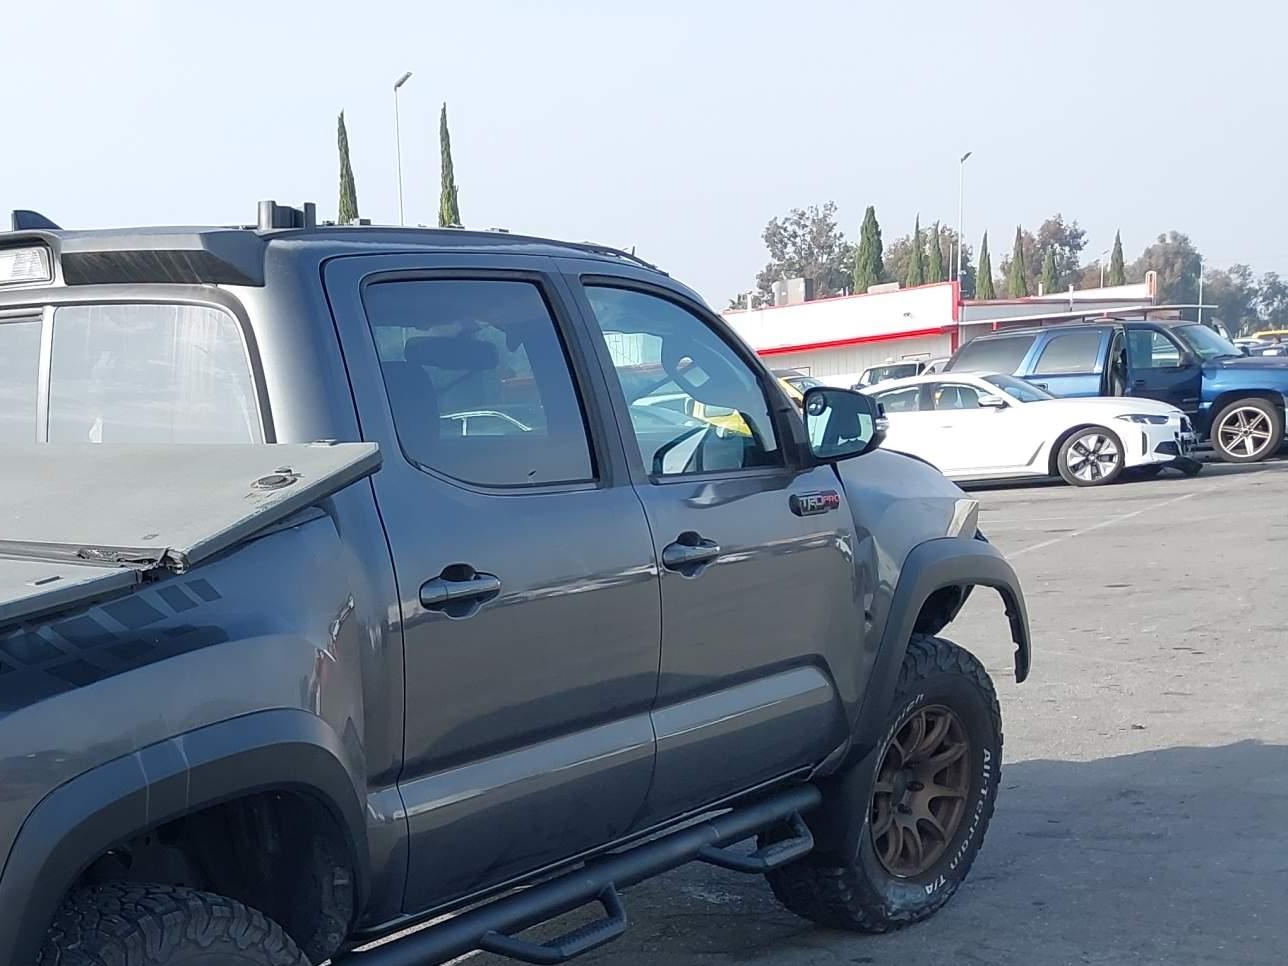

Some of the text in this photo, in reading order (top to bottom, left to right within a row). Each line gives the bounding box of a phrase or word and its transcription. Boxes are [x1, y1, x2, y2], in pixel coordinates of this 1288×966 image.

[800, 496, 824, 511] TRD
[924, 748, 991, 895] All-Terrain T/A
